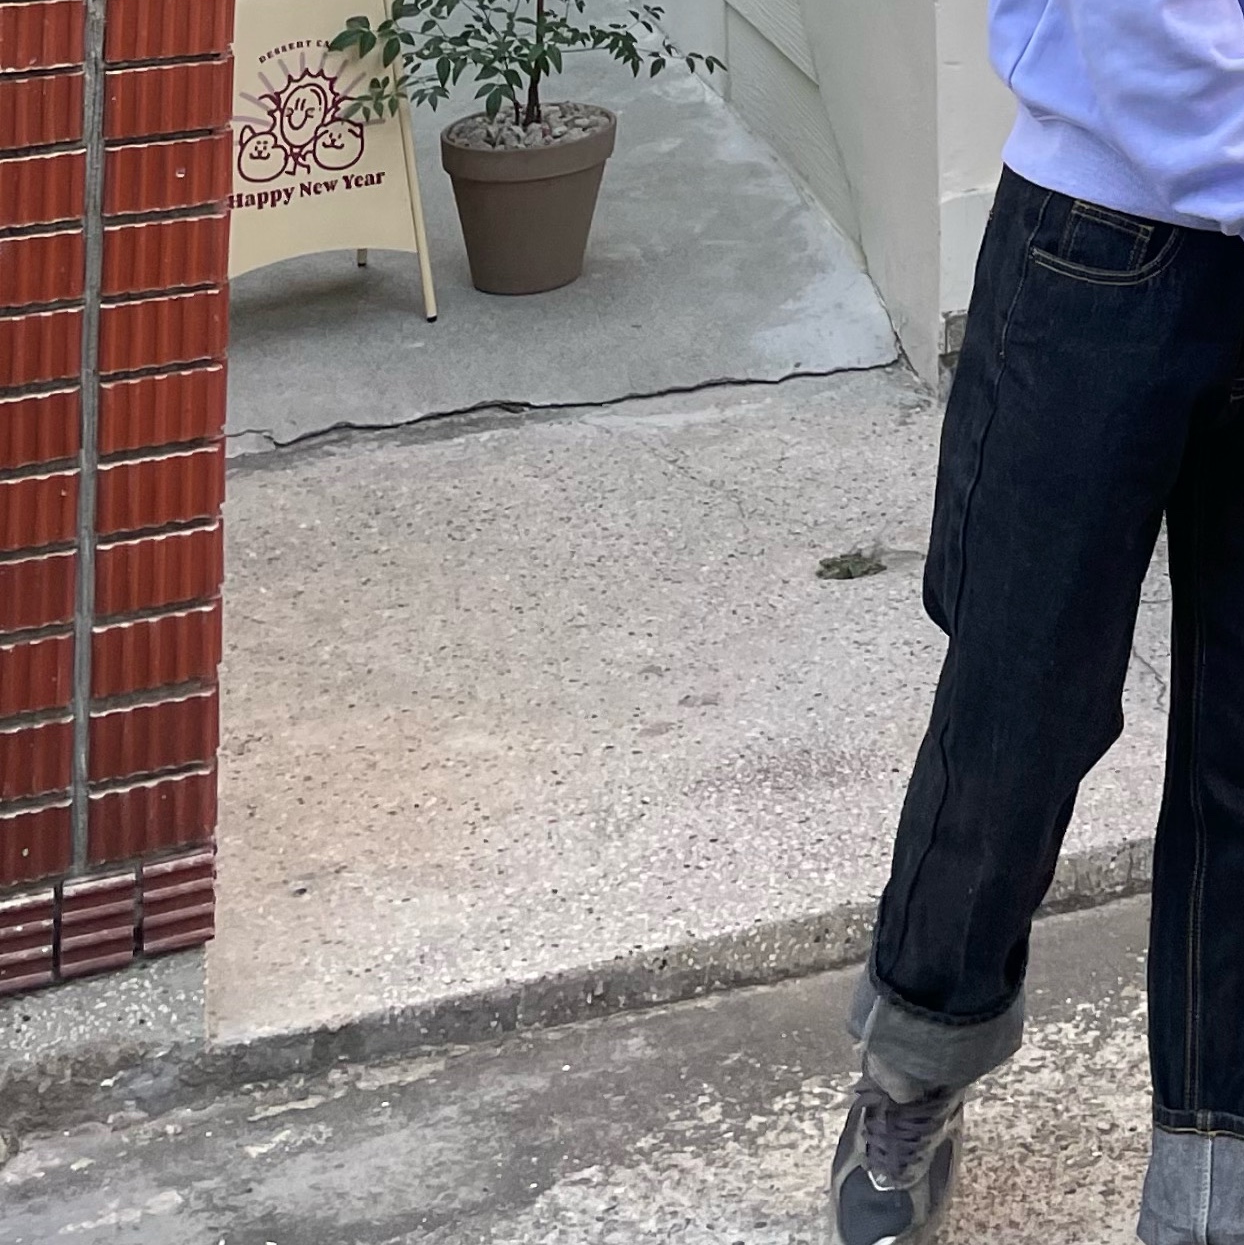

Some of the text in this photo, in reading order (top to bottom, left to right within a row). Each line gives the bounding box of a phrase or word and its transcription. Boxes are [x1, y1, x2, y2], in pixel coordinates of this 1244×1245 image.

[228, 171, 386, 210] Happy New Year
